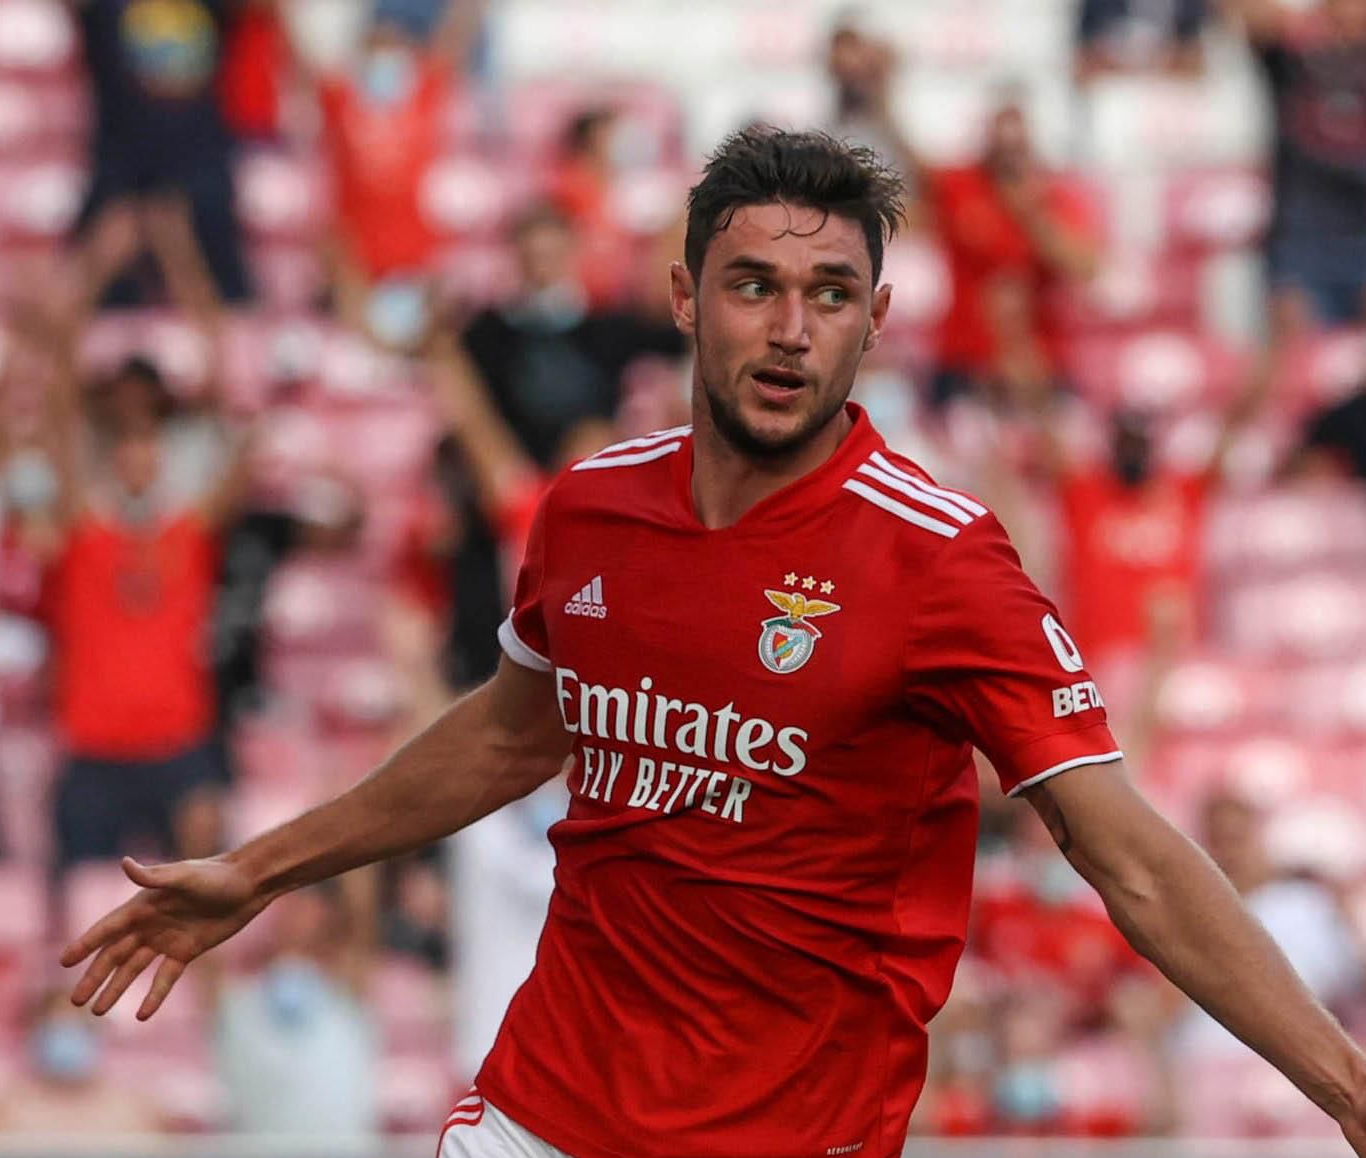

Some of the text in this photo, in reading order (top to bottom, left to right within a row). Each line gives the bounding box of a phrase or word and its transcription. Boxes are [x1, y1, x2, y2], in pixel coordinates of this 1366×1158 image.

[564, 601, 608, 619] adidas
[555, 667, 809, 777] Emirates
[579, 746, 753, 824] FLY BETTER
